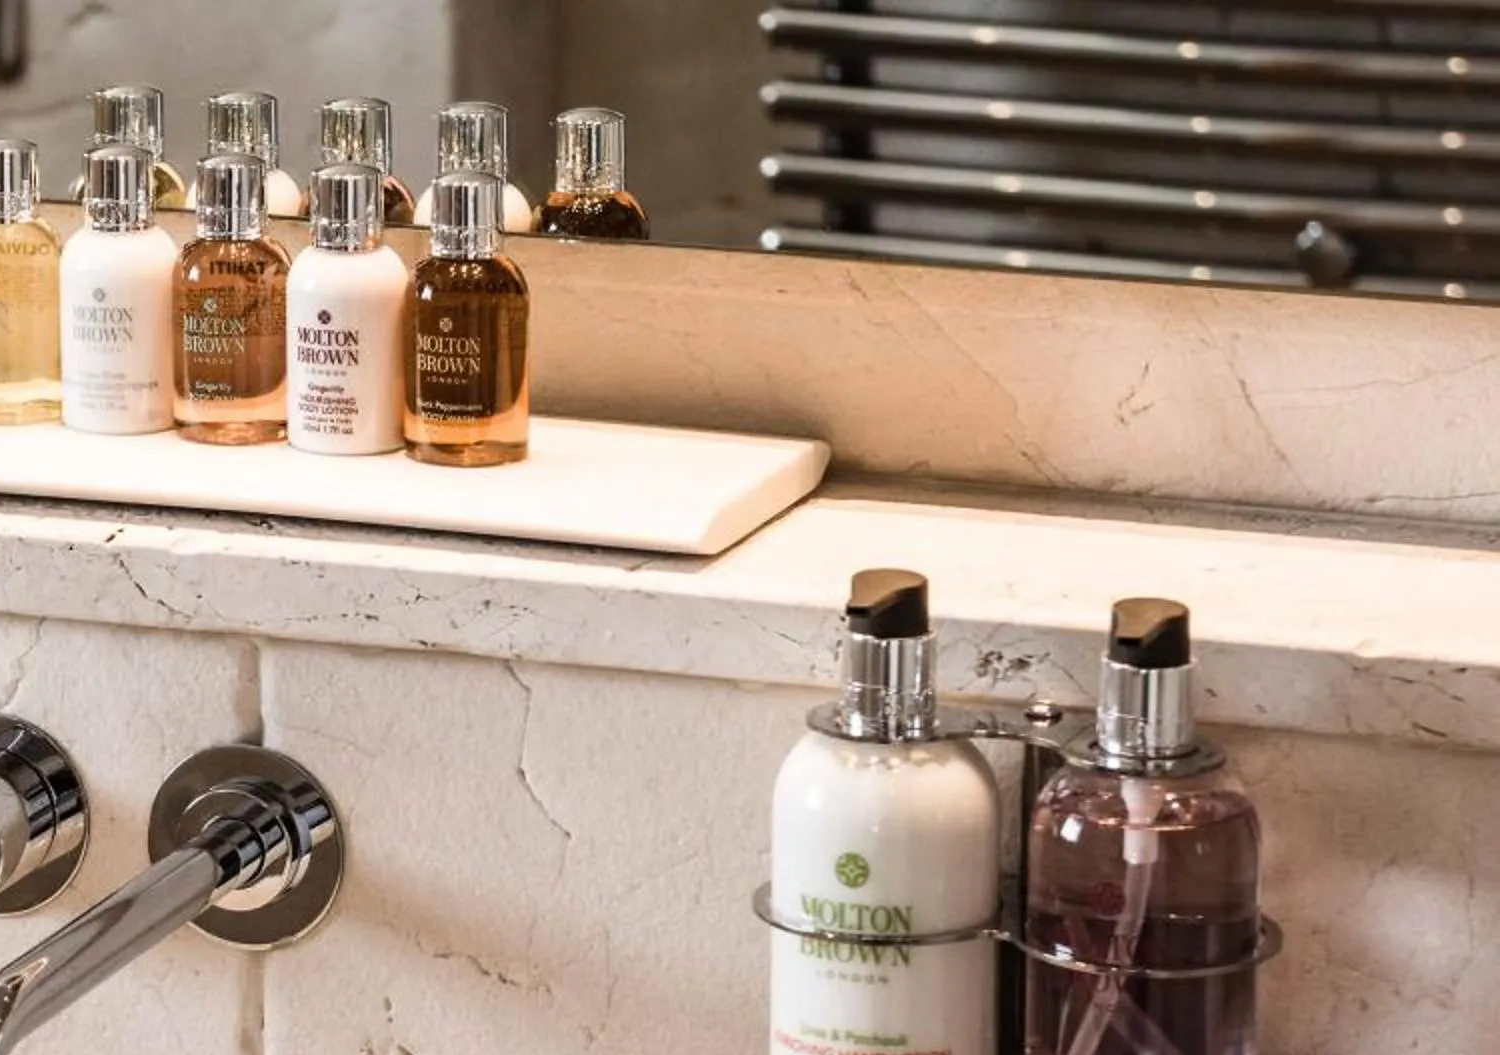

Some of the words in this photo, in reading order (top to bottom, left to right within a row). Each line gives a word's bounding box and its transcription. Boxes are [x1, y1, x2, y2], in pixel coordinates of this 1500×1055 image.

[72, 305, 134, 325] MOLTON
[183, 313, 246, 335] MOLTON
[72, 324, 134, 343] BROWN
[183, 334, 246, 354] BROWN
[297, 326, 360, 347] MOLTON
[416, 333, 481, 356] MOLTON
[297, 345, 360, 367] BROWN
[416, 353, 481, 376] BROWN
[801, 894, 913, 934] MOLTON
[800, 936, 913, 968] BROWN
